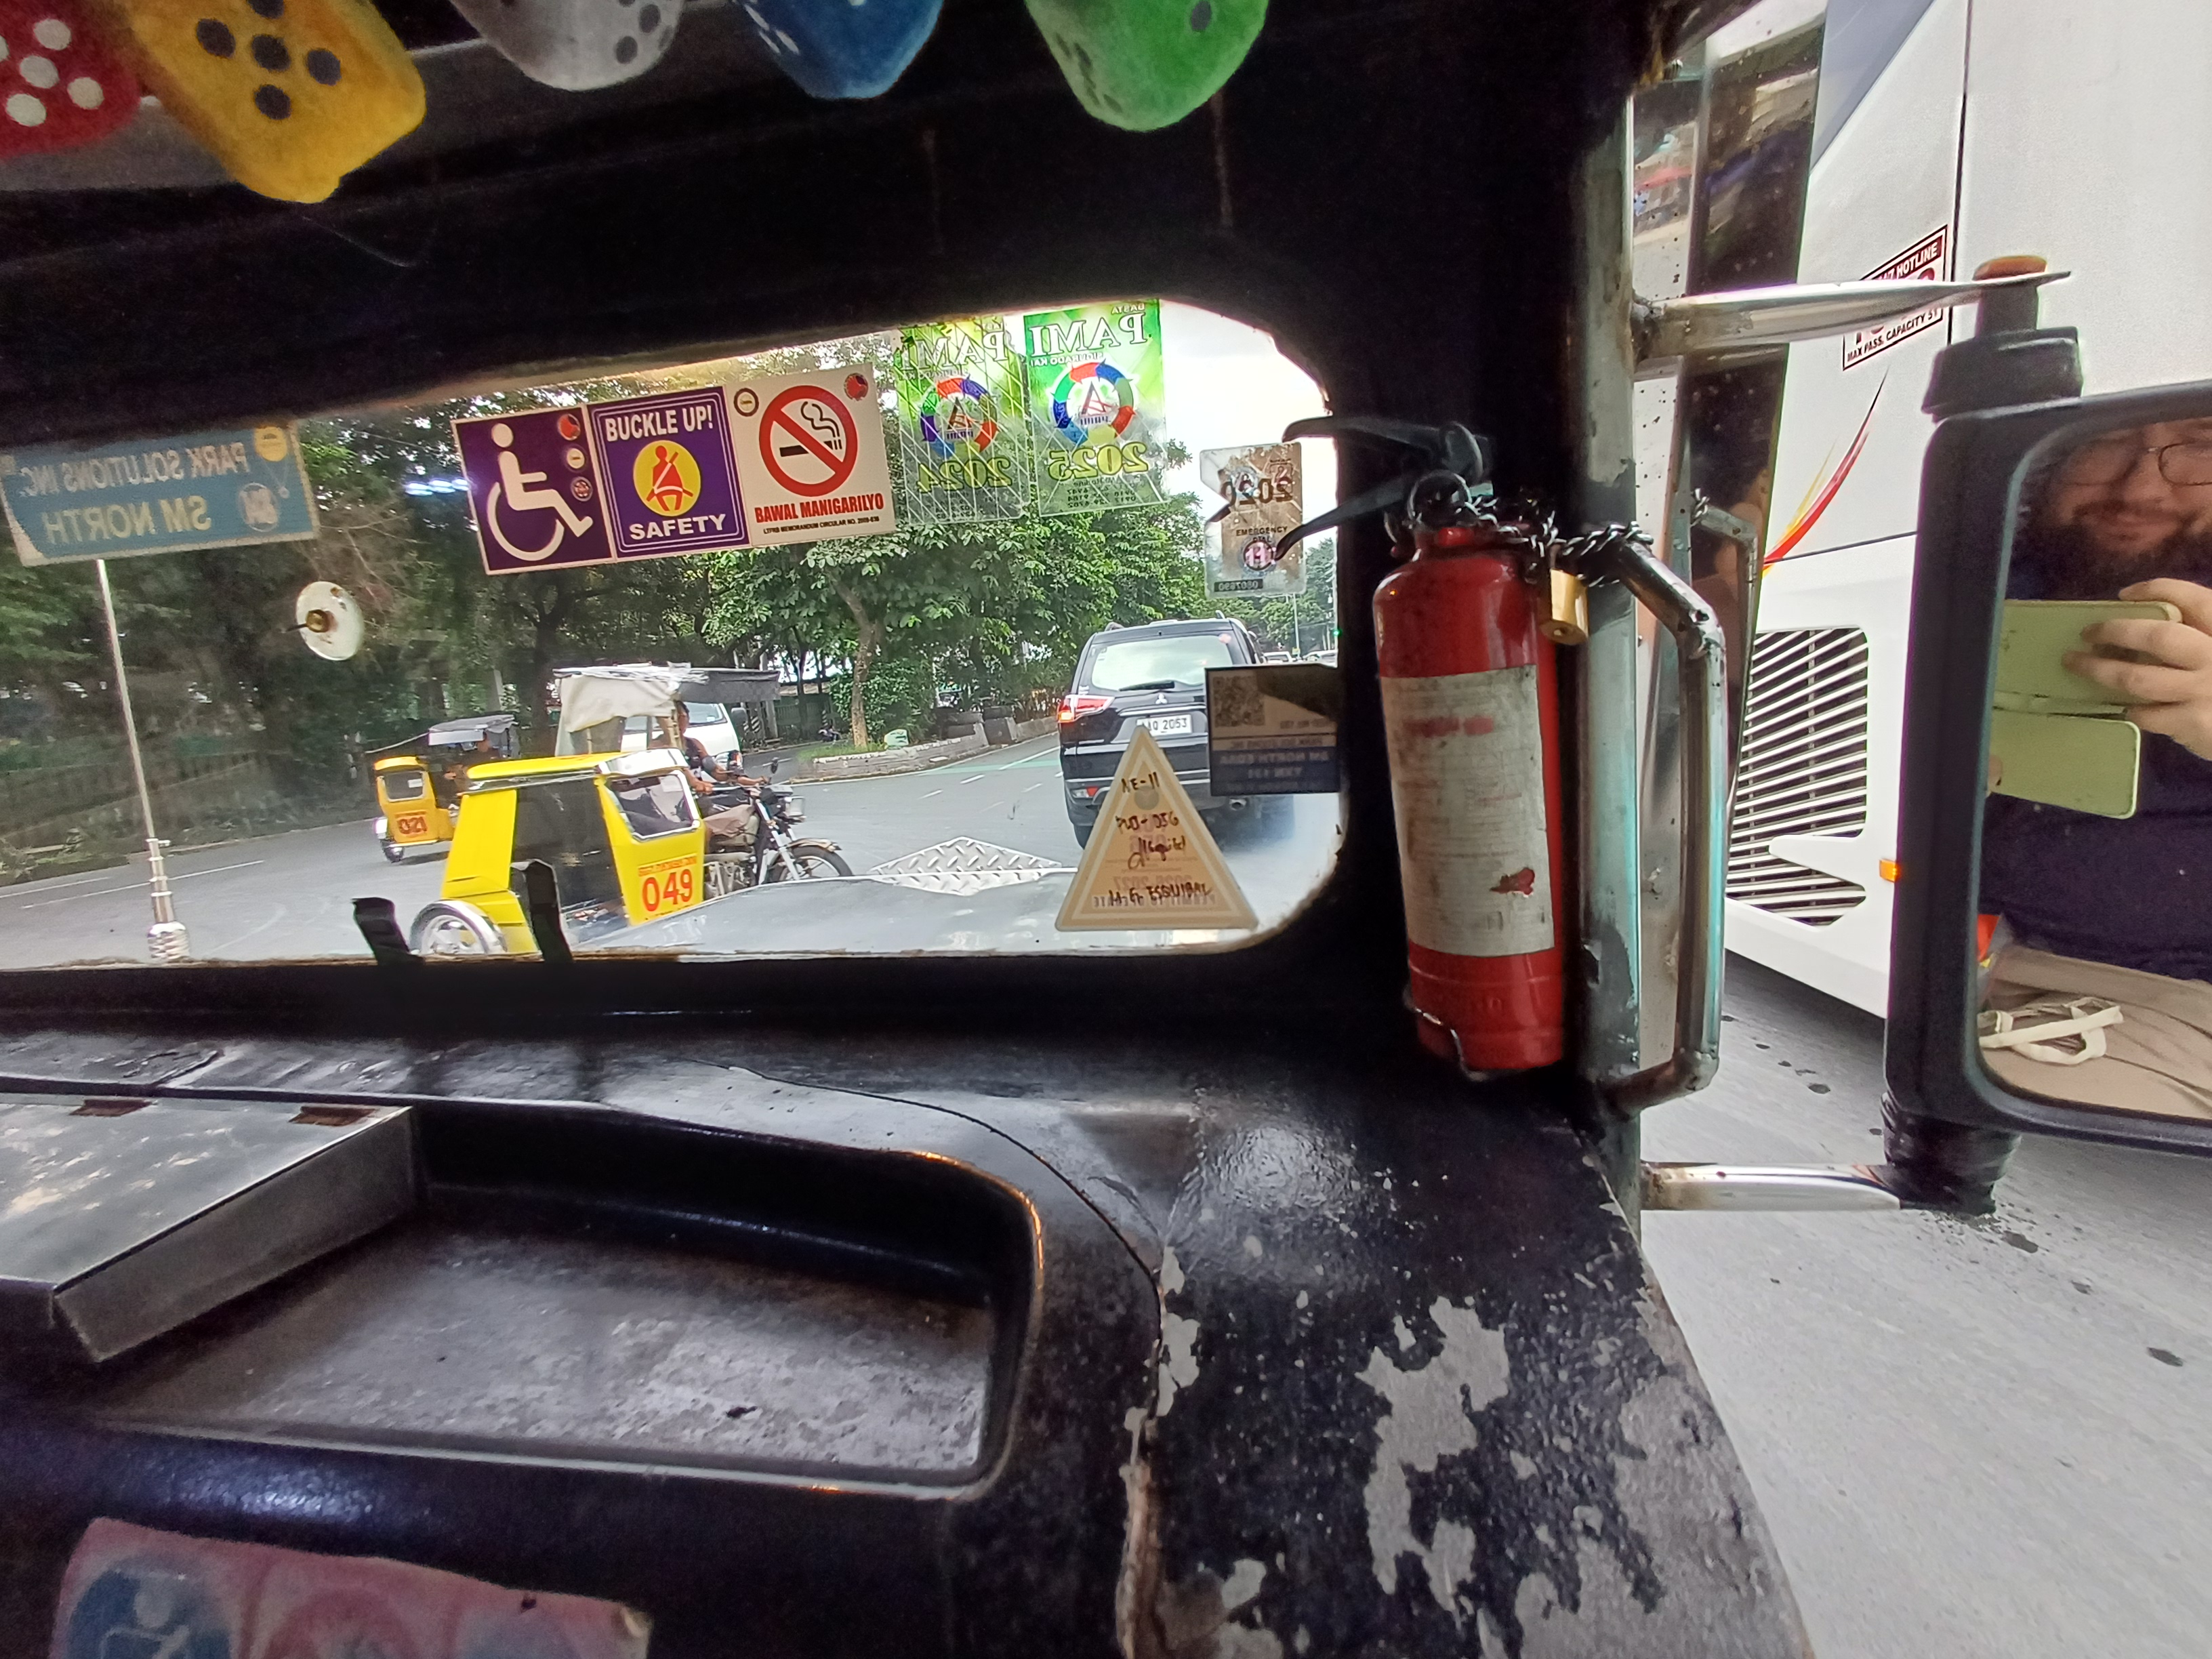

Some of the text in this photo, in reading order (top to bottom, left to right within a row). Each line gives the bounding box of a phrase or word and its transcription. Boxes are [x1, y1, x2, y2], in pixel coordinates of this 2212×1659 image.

[1897, 242, 1938, 277] HOTLINE
[1847, 346, 1862, 362] MAX
[1886, 313, 1926, 341] CAPACITY
[605, 405, 713, 442] BUCKLE UP!
[754, 493, 884, 523] BAWAL MANIGARILYO
[629, 514, 726, 540] SAFETY
[1236, 526, 1288, 537] EMERGENCY
[642, 868, 693, 912] 049
